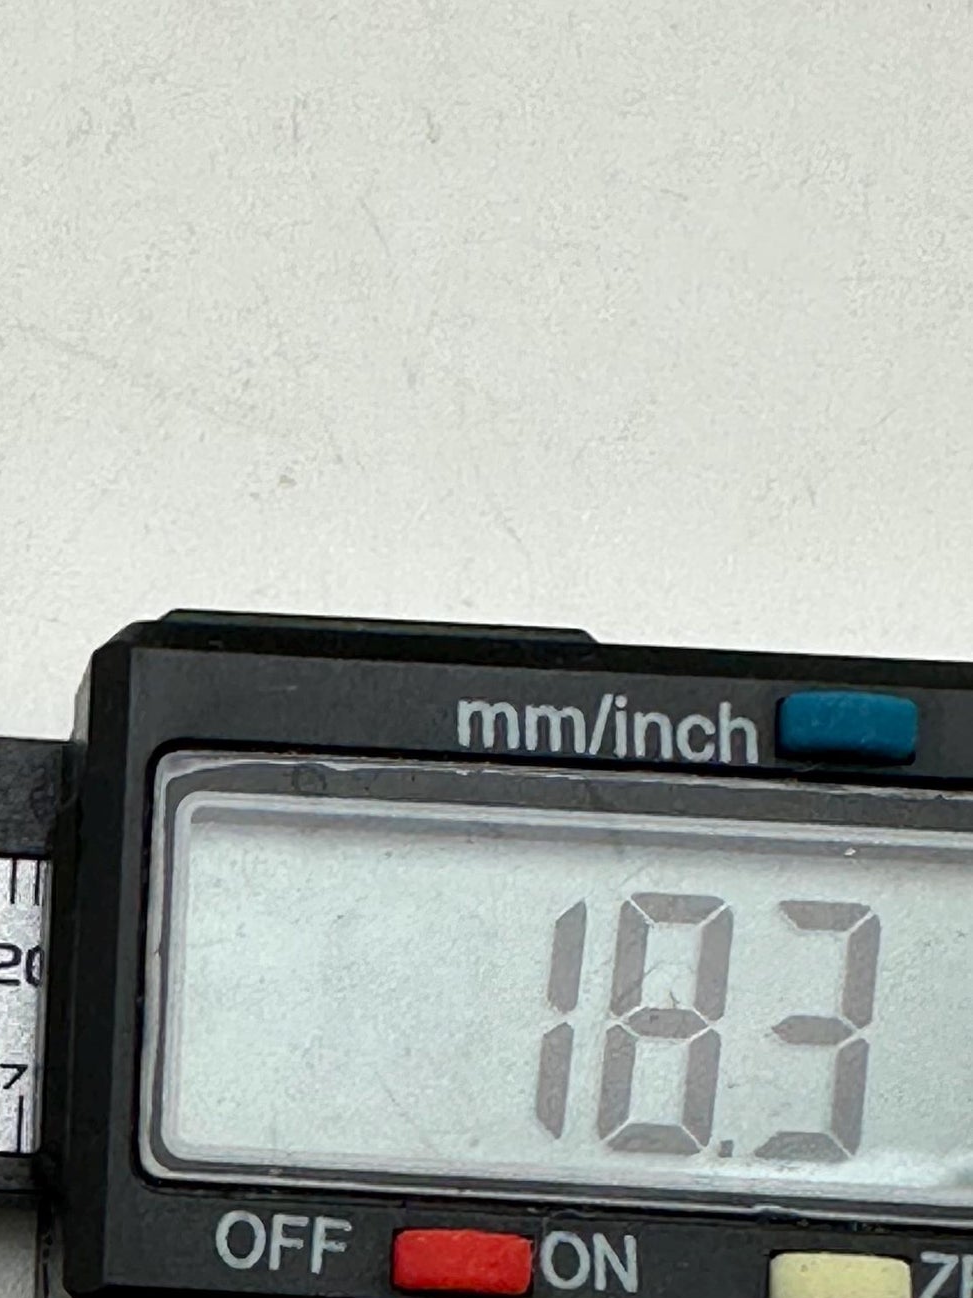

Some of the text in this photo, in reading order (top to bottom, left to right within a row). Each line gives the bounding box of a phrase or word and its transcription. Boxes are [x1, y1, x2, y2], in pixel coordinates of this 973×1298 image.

[457, 693, 760, 765] mm/inch
[535, 892, 881, 1162] 18.3
[0, 1063, 27, 1090] 7
[215, 1210, 353, 1275] OFF
[540, 1230, 639, 1294] ON
